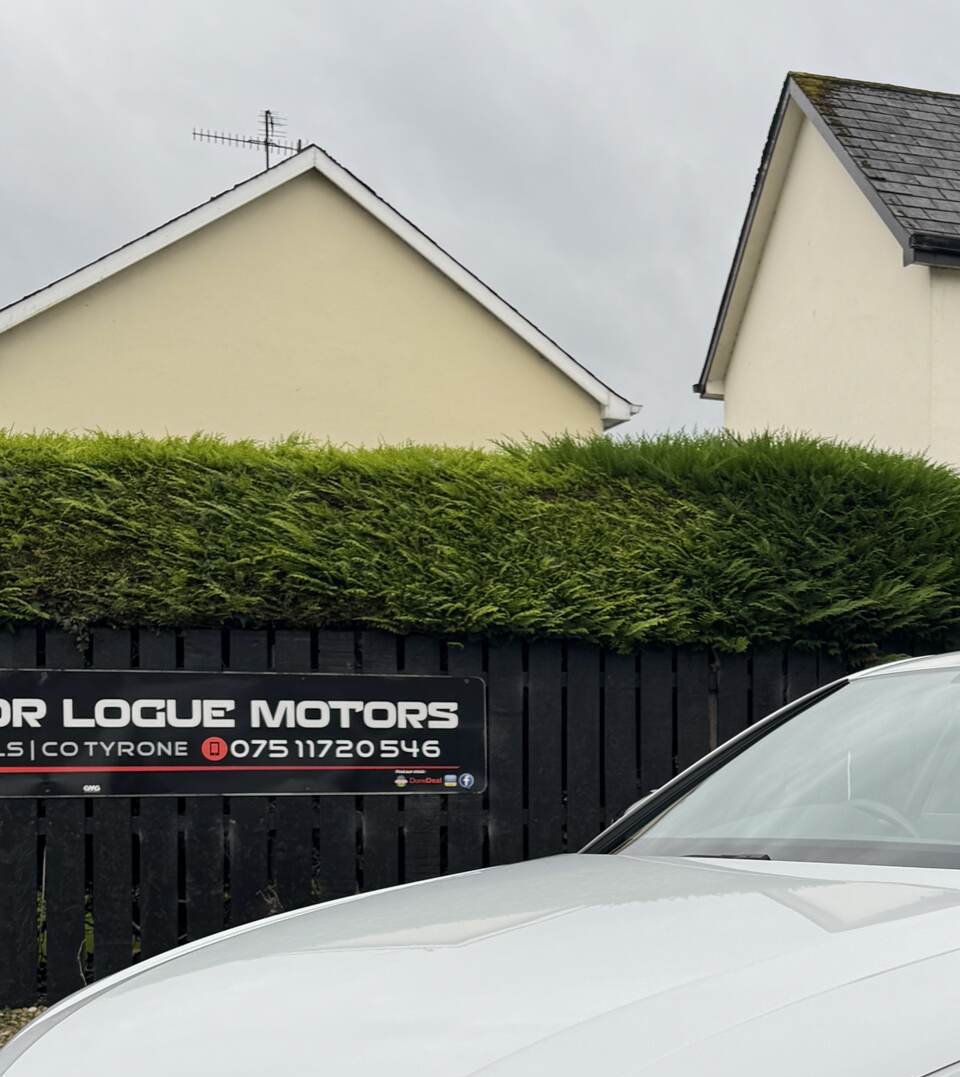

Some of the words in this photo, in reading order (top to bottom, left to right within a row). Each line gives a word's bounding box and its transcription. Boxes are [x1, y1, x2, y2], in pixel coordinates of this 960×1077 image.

[63, 698, 236, 728] LOGUE
[250, 699, 459, 729] MOTORS
[42, 741, 79, 757] CO
[84, 741, 189, 757] TYRONE
[230, 739, 289, 759] 075
[295, 739, 375, 759] 11720
[380, 740, 441, 758] 546
